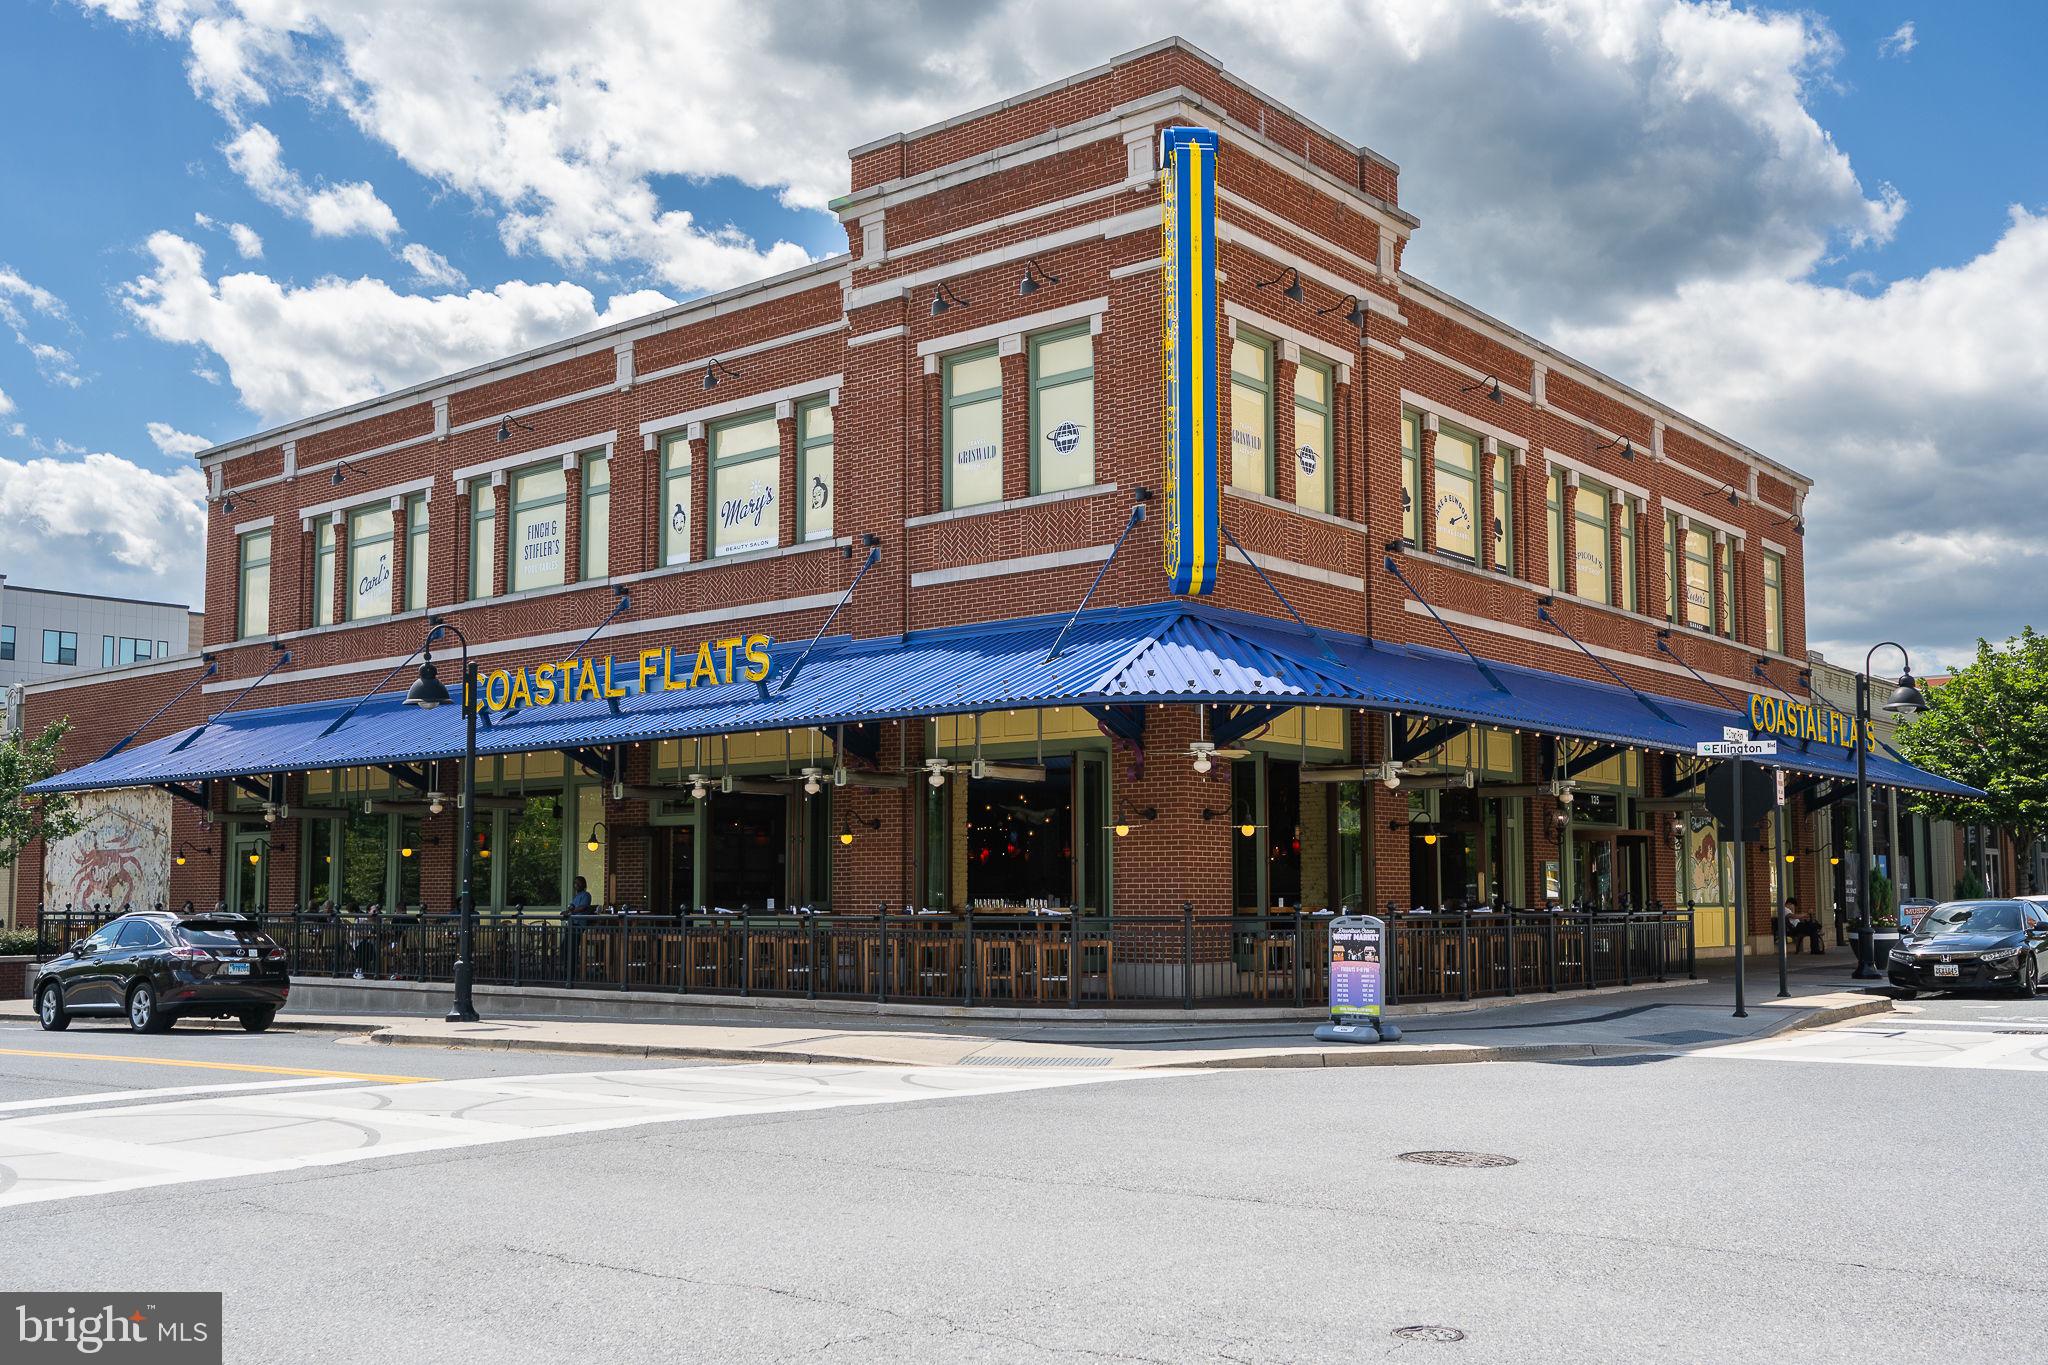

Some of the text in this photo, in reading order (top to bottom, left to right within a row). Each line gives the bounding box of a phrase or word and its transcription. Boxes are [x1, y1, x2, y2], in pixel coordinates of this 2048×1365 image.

[958, 445, 997, 465] GRISWALD
[721, 486, 775, 529] Mary's
[527, 520, 558, 541] FINCH &
[524, 539, 560, 561] STIFLER'S
[725, 540, 769, 552] BEAUTY SALON
[359, 563, 390, 596] Carl's
[639, 634, 777, 694] FLATS
[1751, 694, 1876, 752] COASTAL FLAS
[1712, 743, 1762, 756] Ellington
[1904, 907, 1929, 915] MUSIC
[1332, 933, 1379, 942] NIGHT MARKET
